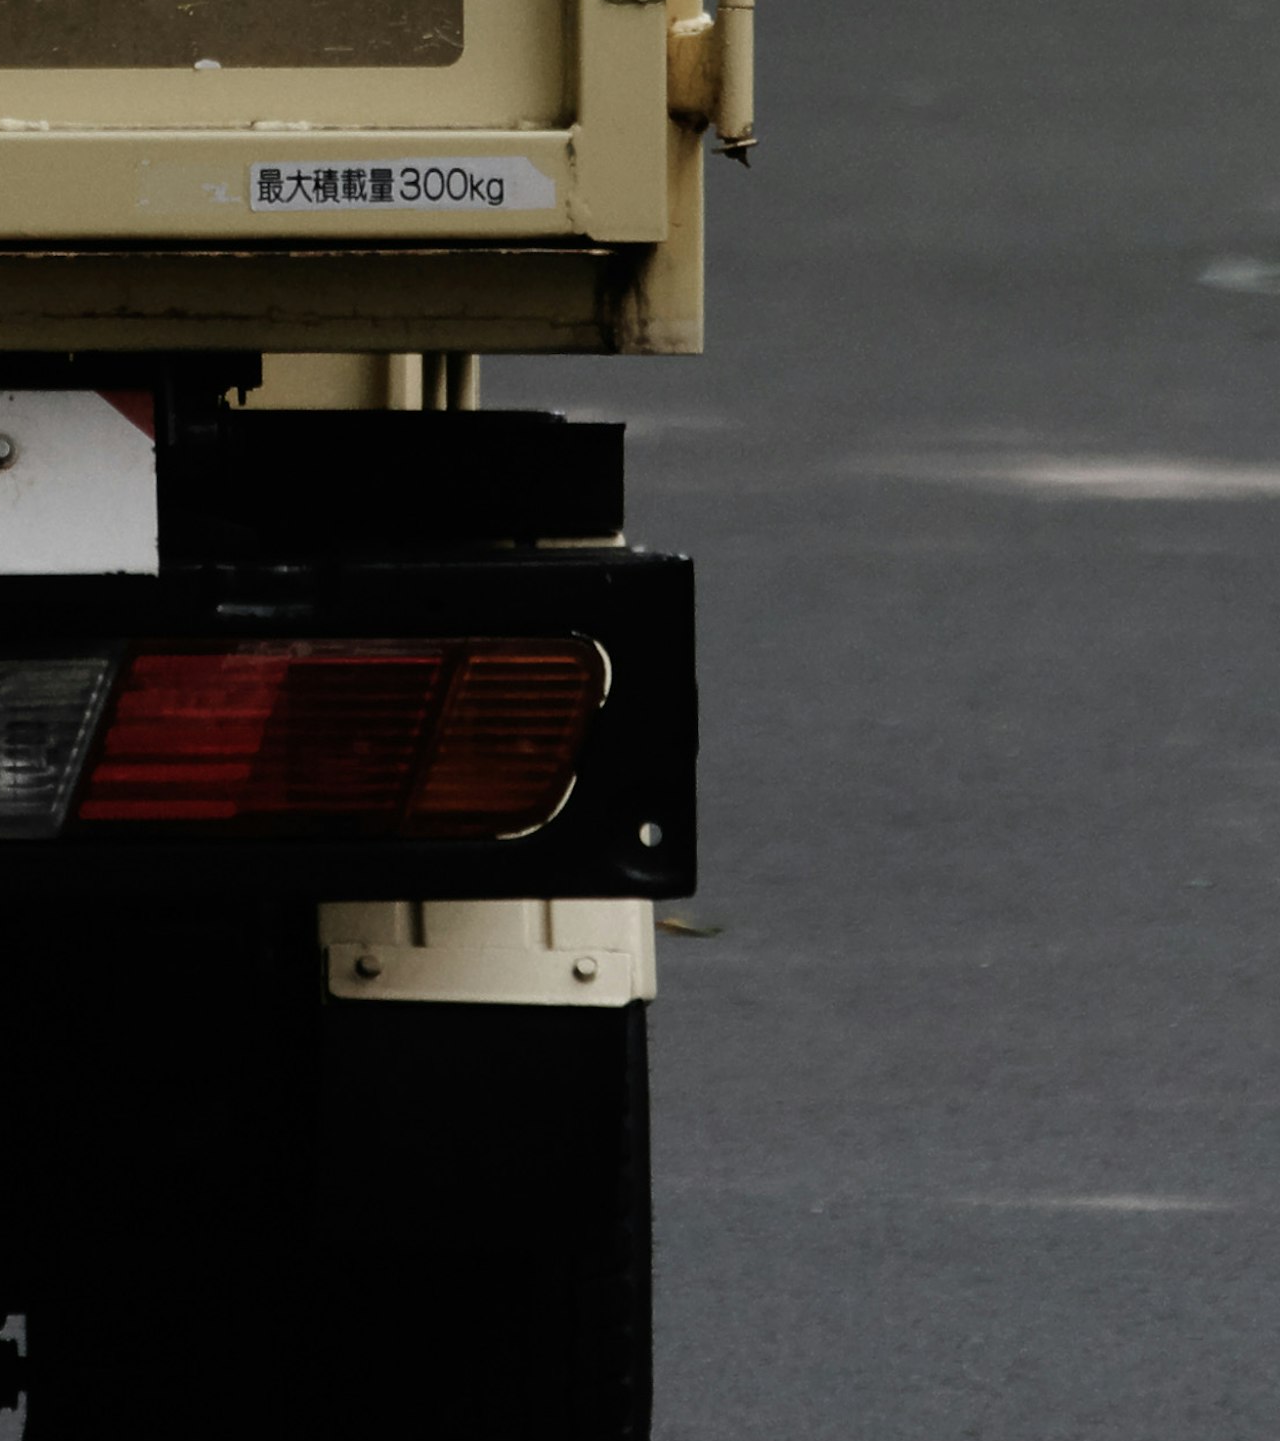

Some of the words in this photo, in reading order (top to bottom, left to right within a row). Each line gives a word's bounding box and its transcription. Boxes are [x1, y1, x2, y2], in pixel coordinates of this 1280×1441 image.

[256, 167, 505, 205] 最大積載量300kg
